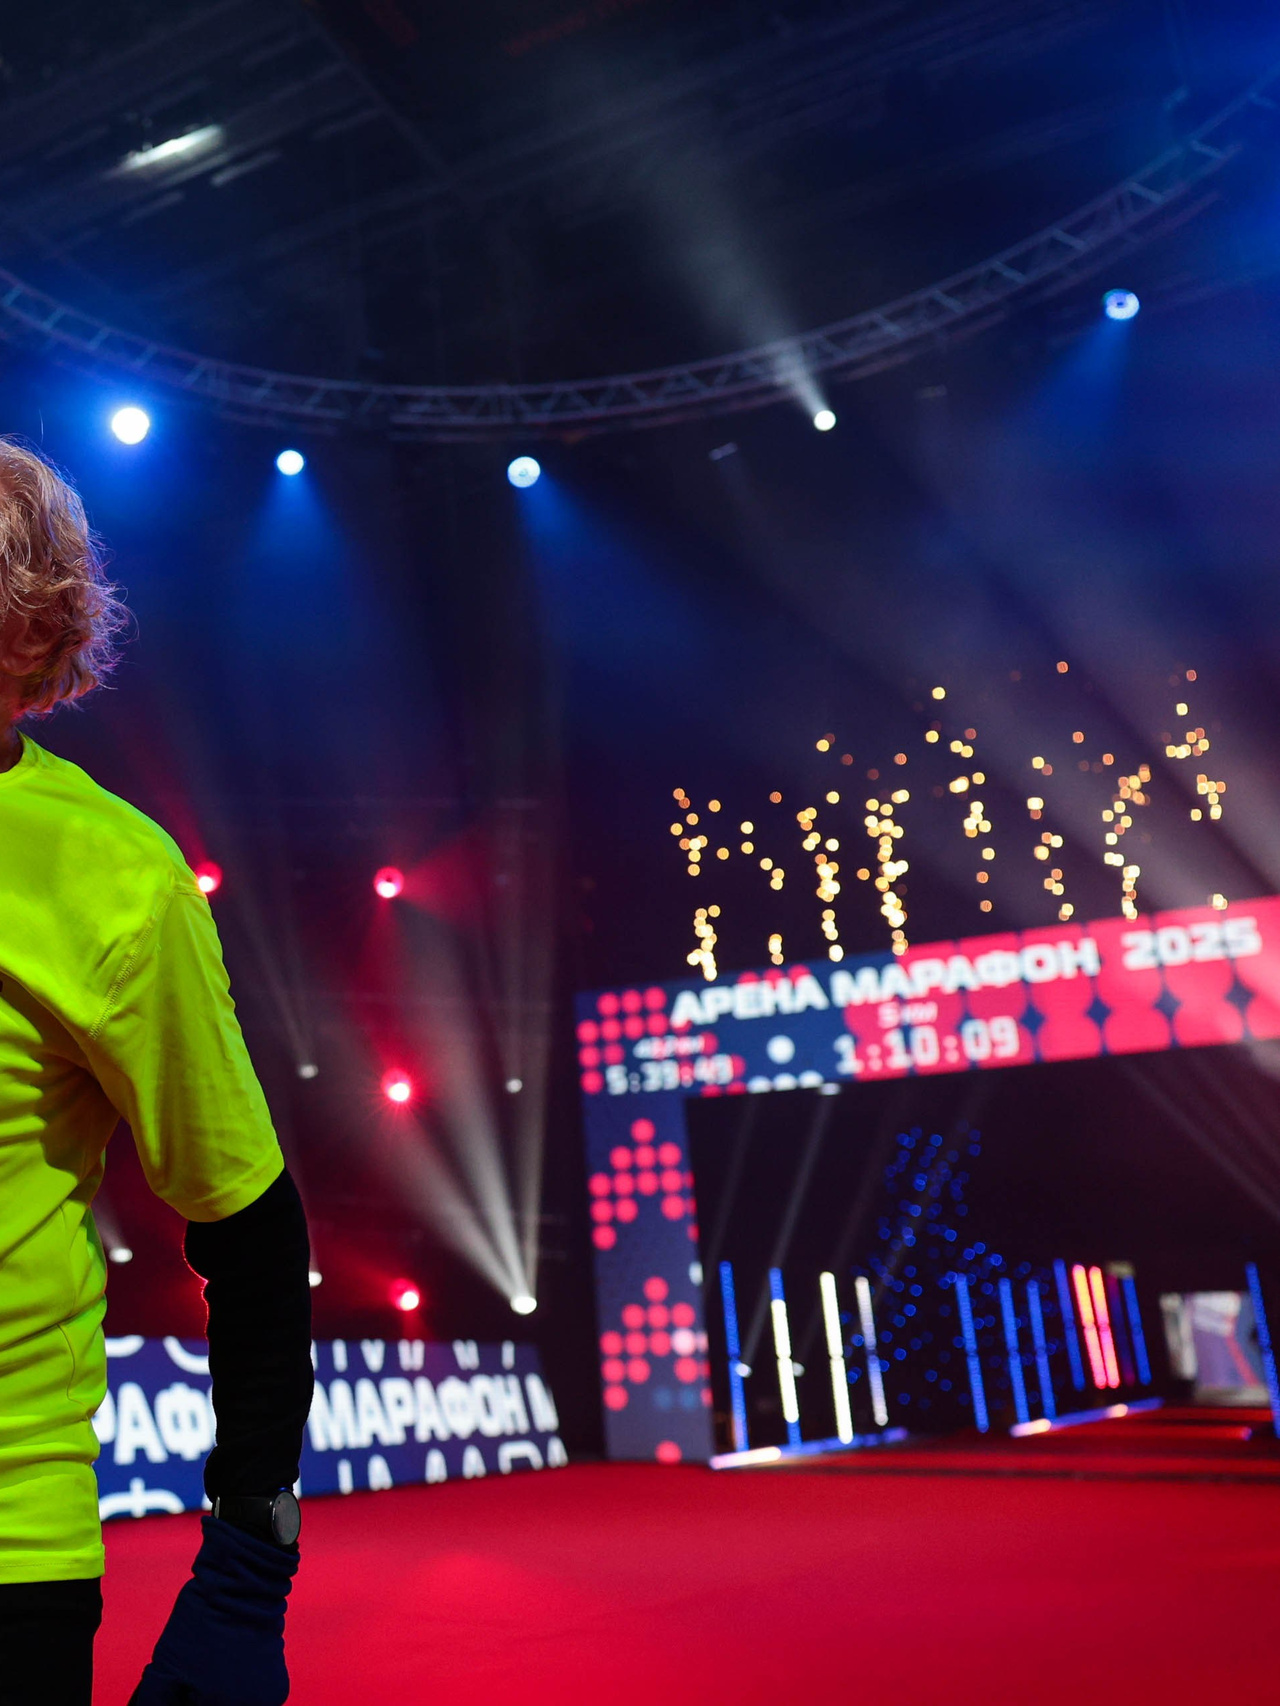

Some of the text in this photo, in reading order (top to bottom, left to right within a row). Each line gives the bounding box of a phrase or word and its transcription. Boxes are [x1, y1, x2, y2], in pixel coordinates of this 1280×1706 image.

[670, 916, 1262, 1027] АРЕНА МАРАФОН 2025
[833, 1015, 1021, 1076] 1:10:09
[306, 1375, 530, 1452] МАРАФОН
